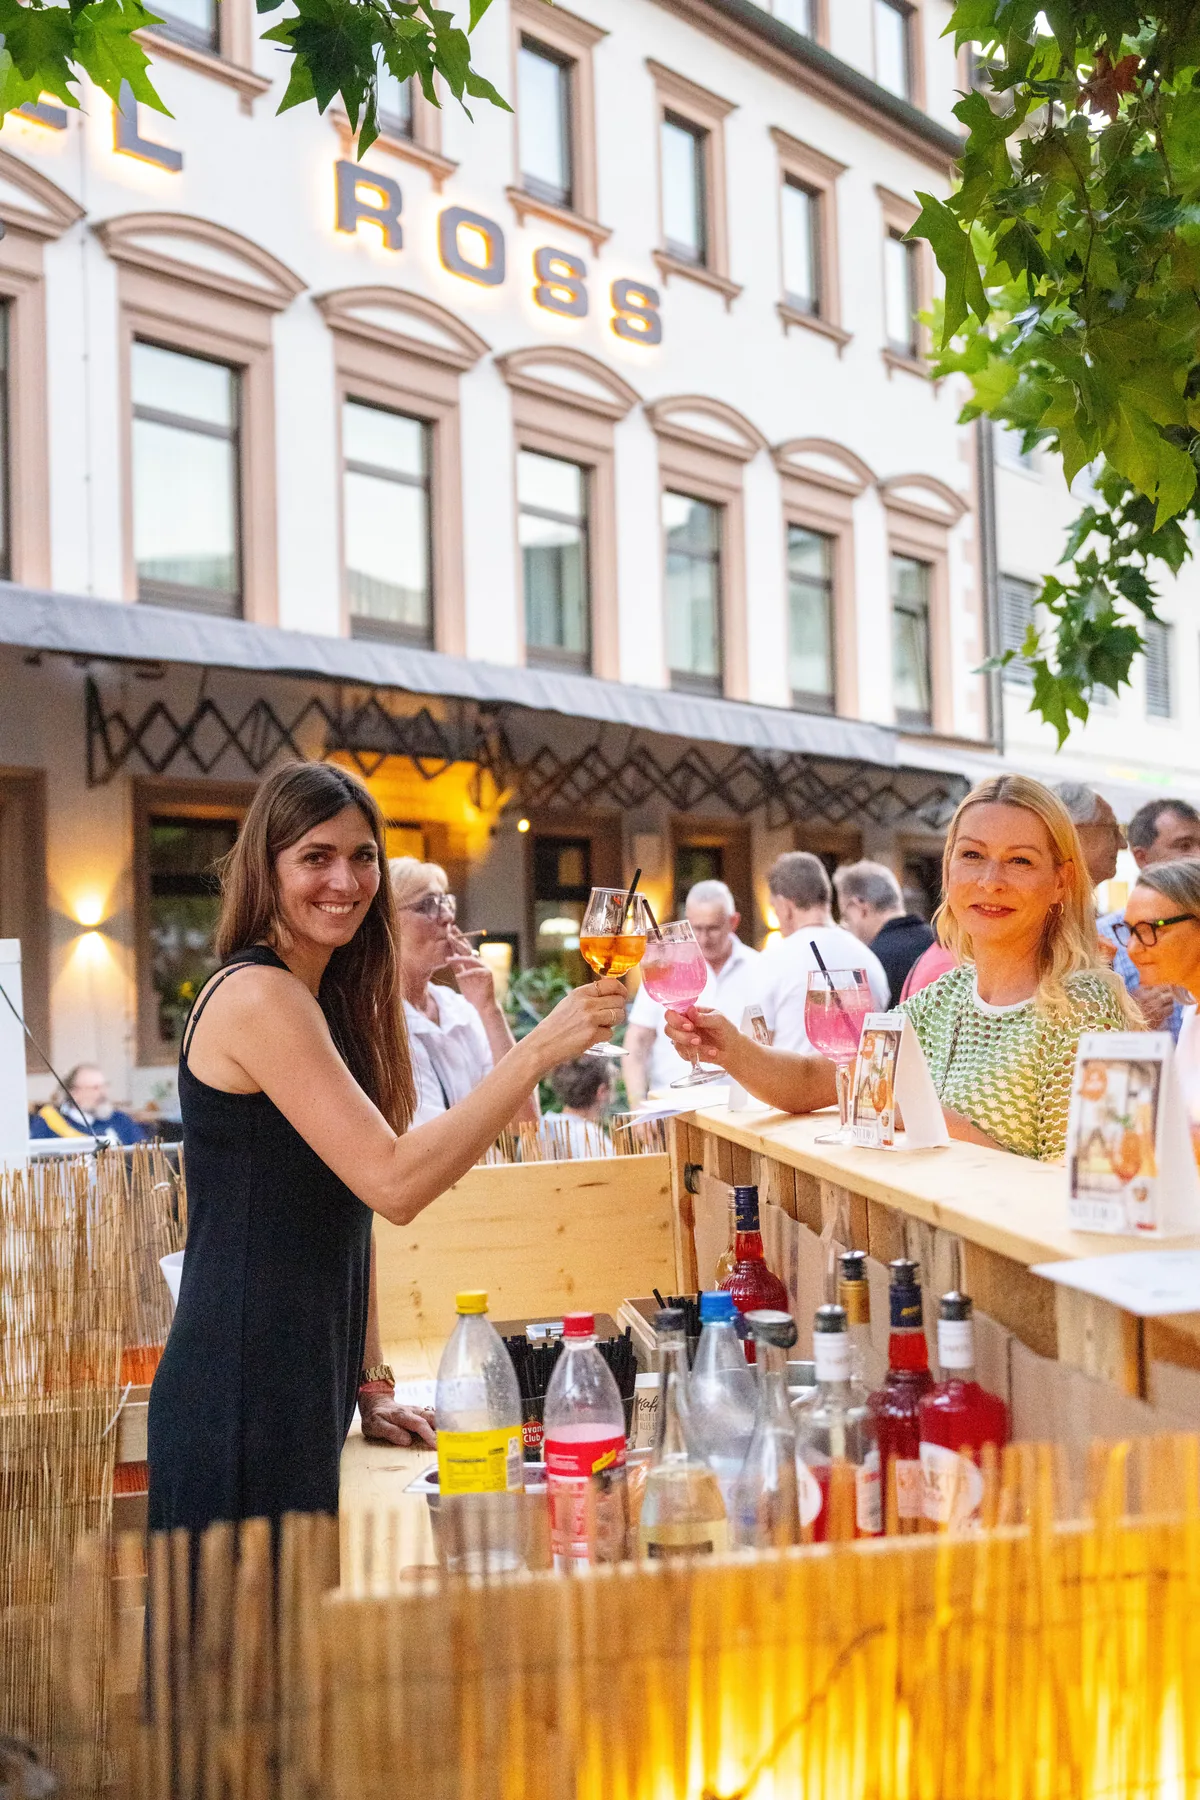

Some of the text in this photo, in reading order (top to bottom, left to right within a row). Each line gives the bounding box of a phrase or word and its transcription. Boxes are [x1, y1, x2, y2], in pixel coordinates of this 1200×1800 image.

[335, 159, 662, 345] ROSS
[522, 1425, 545, 1434] avana
[523, 1433, 541, 1443] Club
